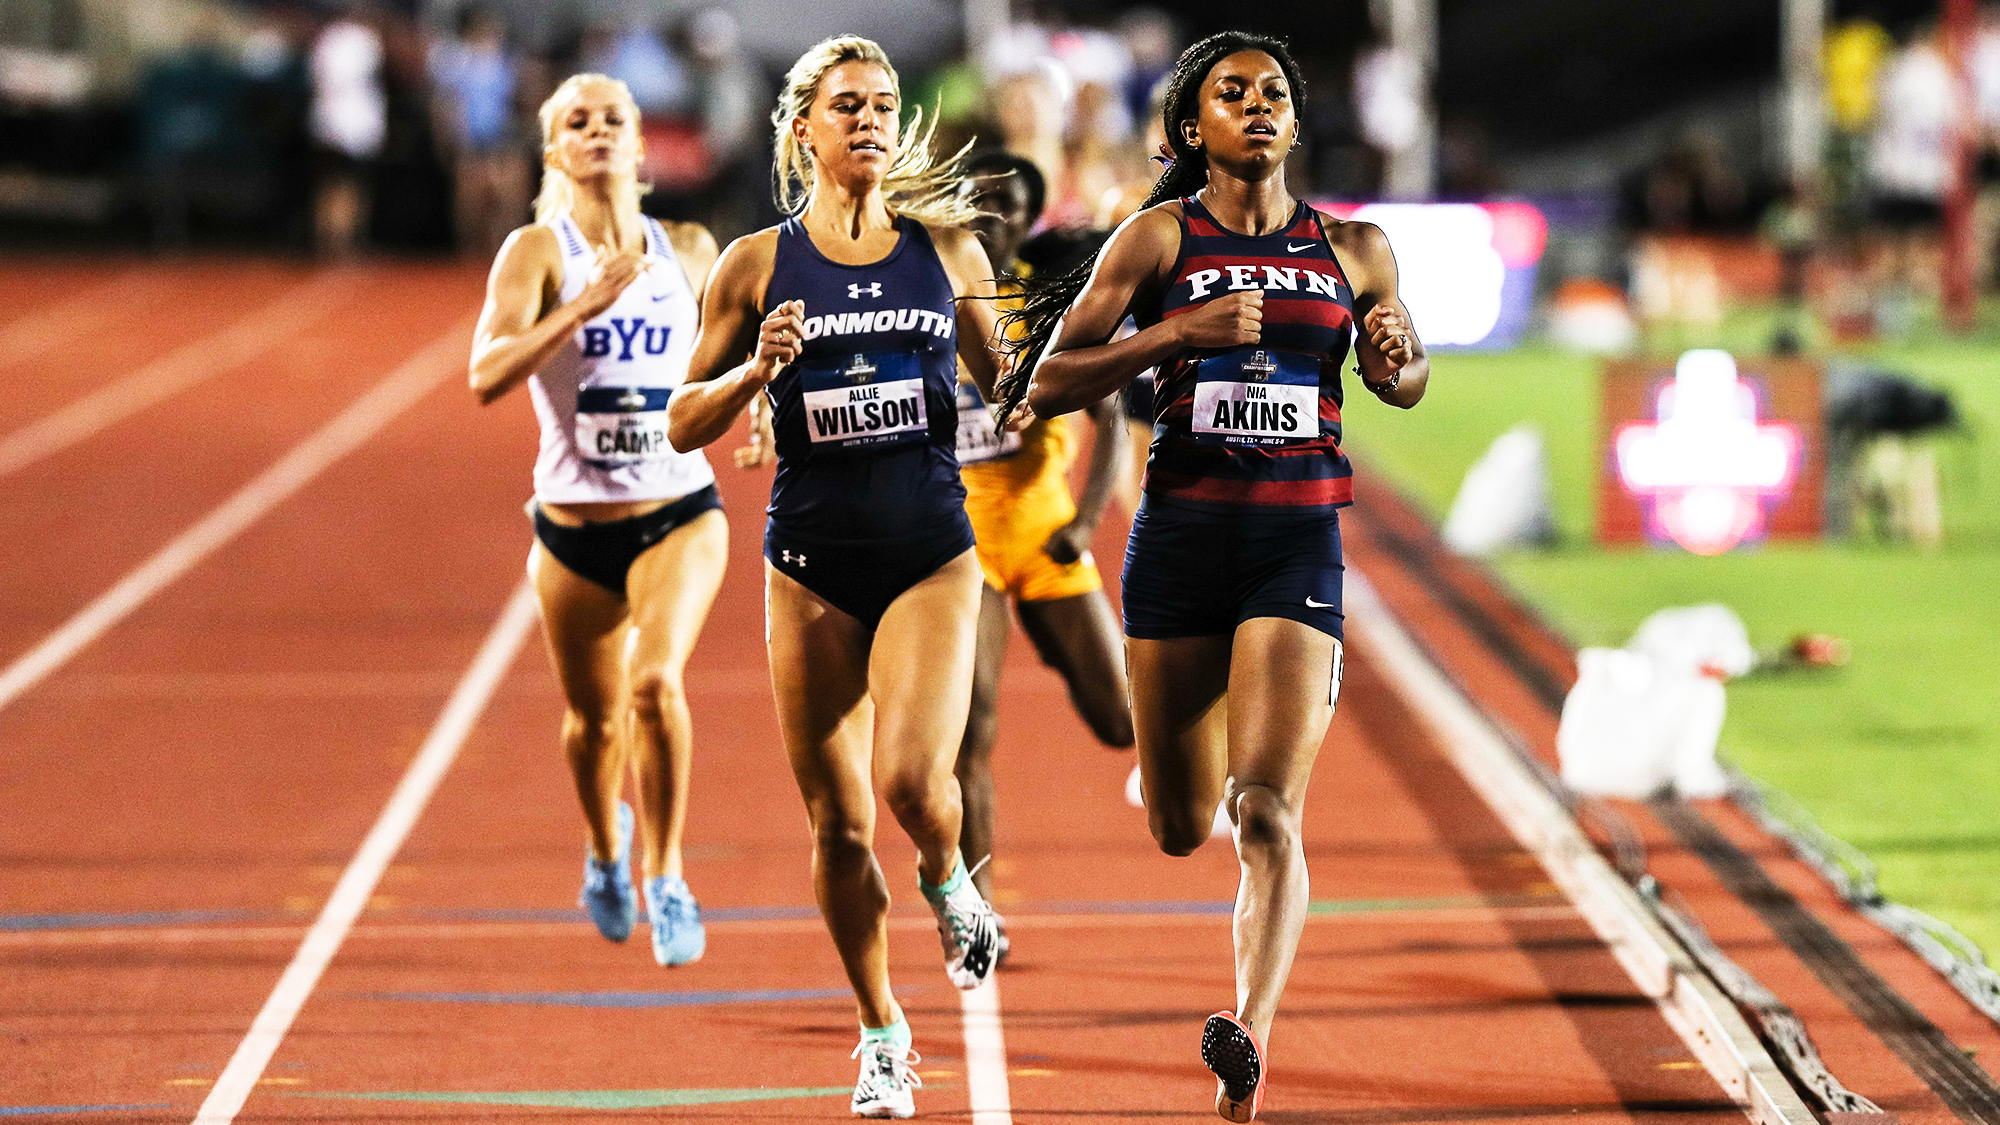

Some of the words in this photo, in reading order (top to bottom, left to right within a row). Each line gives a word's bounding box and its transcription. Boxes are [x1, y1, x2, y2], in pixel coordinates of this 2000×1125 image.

[1185, 265, 1339, 301] PENN
[582, 317, 671, 361] BYU
[801, 308, 954, 342] ONMOUTH
[848, 386, 880, 403] ALLIE
[1246, 385, 1267, 400] NIA
[812, 396, 920, 437] WILSON
[1212, 399, 1298, 432] AKINS
[596, 428, 665, 454] CAMP
